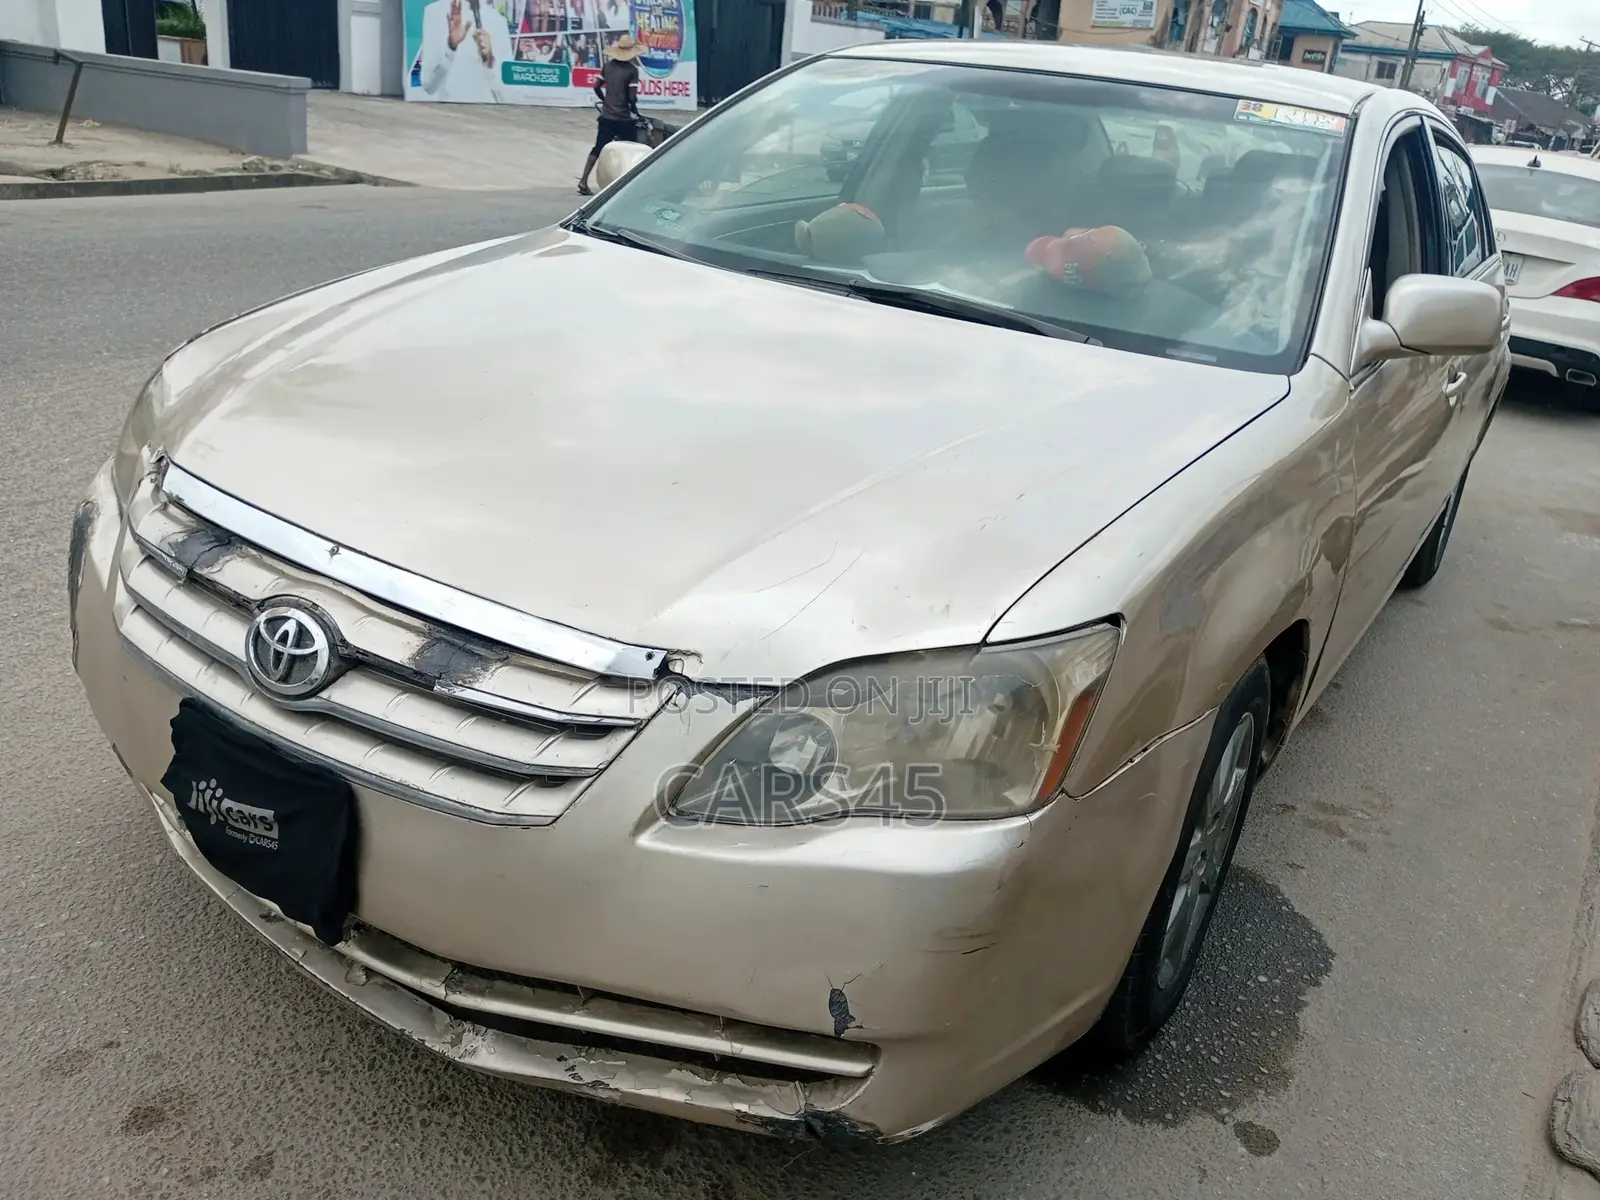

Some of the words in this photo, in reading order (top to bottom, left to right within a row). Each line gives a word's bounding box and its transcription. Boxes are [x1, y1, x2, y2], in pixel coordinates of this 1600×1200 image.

[513, 72, 540, 82] MARCH
[636, 80, 662, 96] OLDS
[664, 81, 690, 97] HERE
[225, 825, 249, 844] formerly
[255, 836, 279, 850] CARS45
